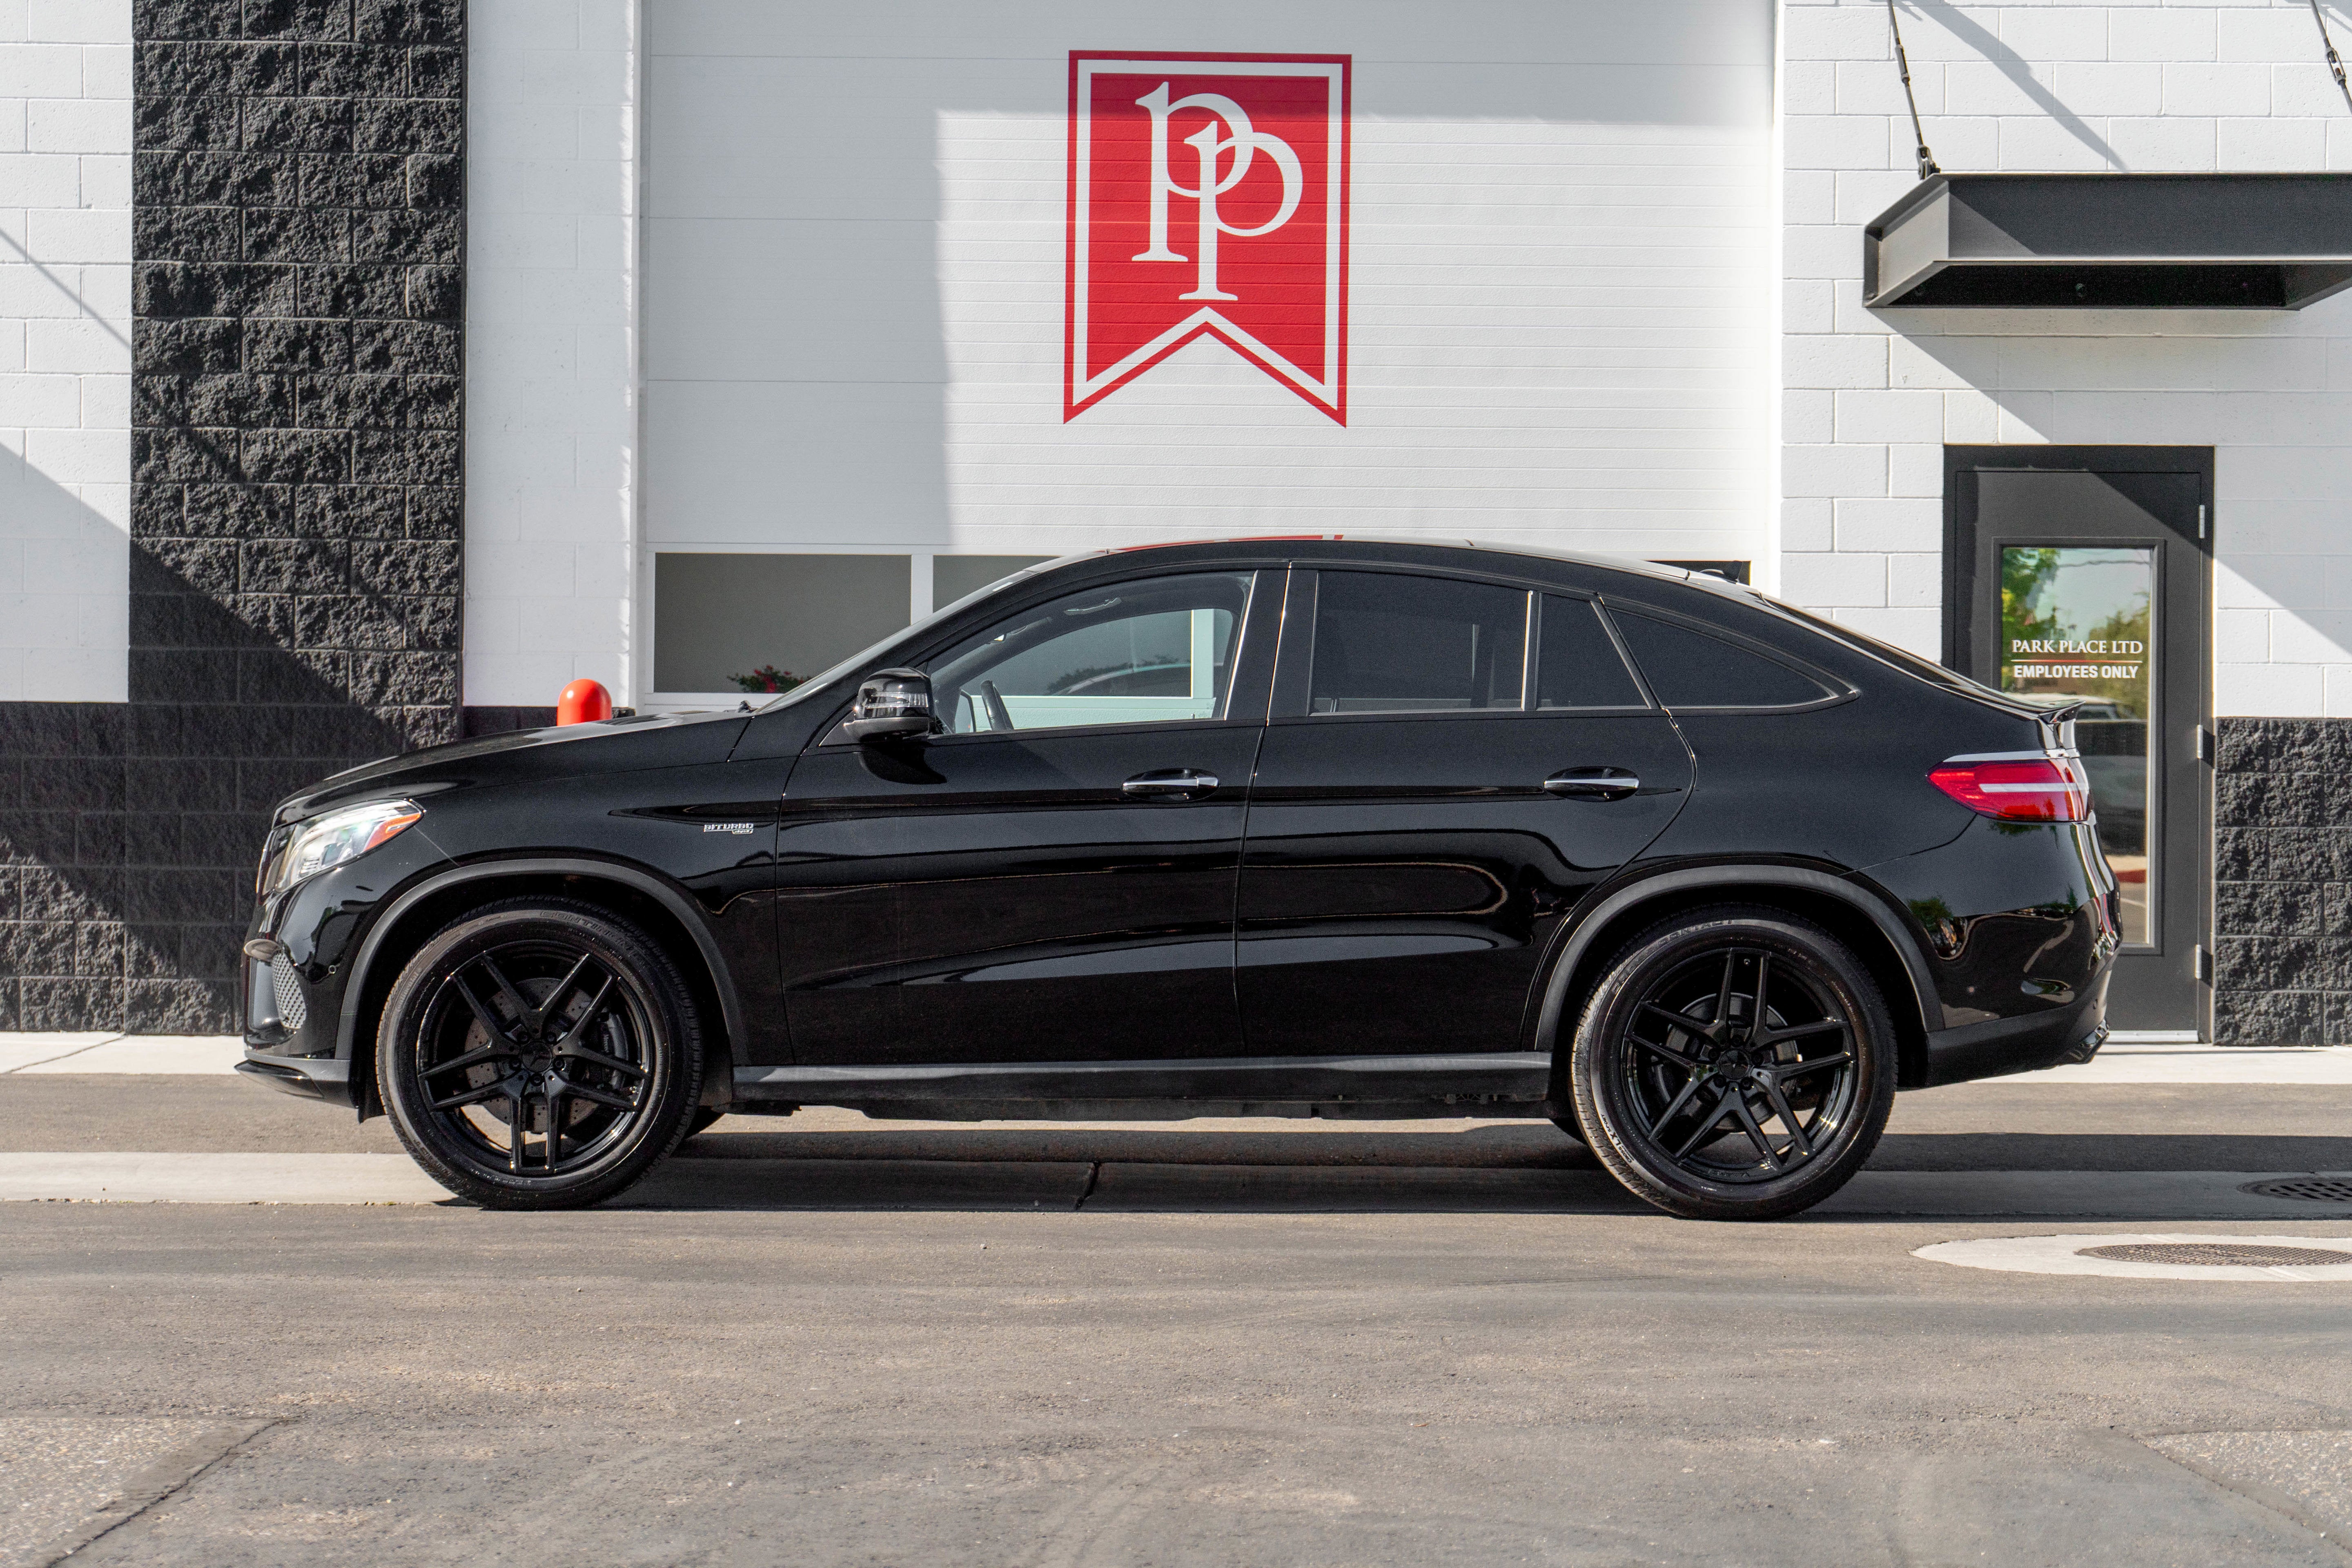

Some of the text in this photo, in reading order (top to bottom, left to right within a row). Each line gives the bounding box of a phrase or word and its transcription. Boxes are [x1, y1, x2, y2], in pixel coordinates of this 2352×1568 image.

[2012, 639, 2143, 654] PARK PLACE LTD
[2013, 665, 2139, 678] EMPLOYEES ONLY
[1601, 1114, 1612, 1132] SPORT
[1610, 1131, 1621, 1146] LX
